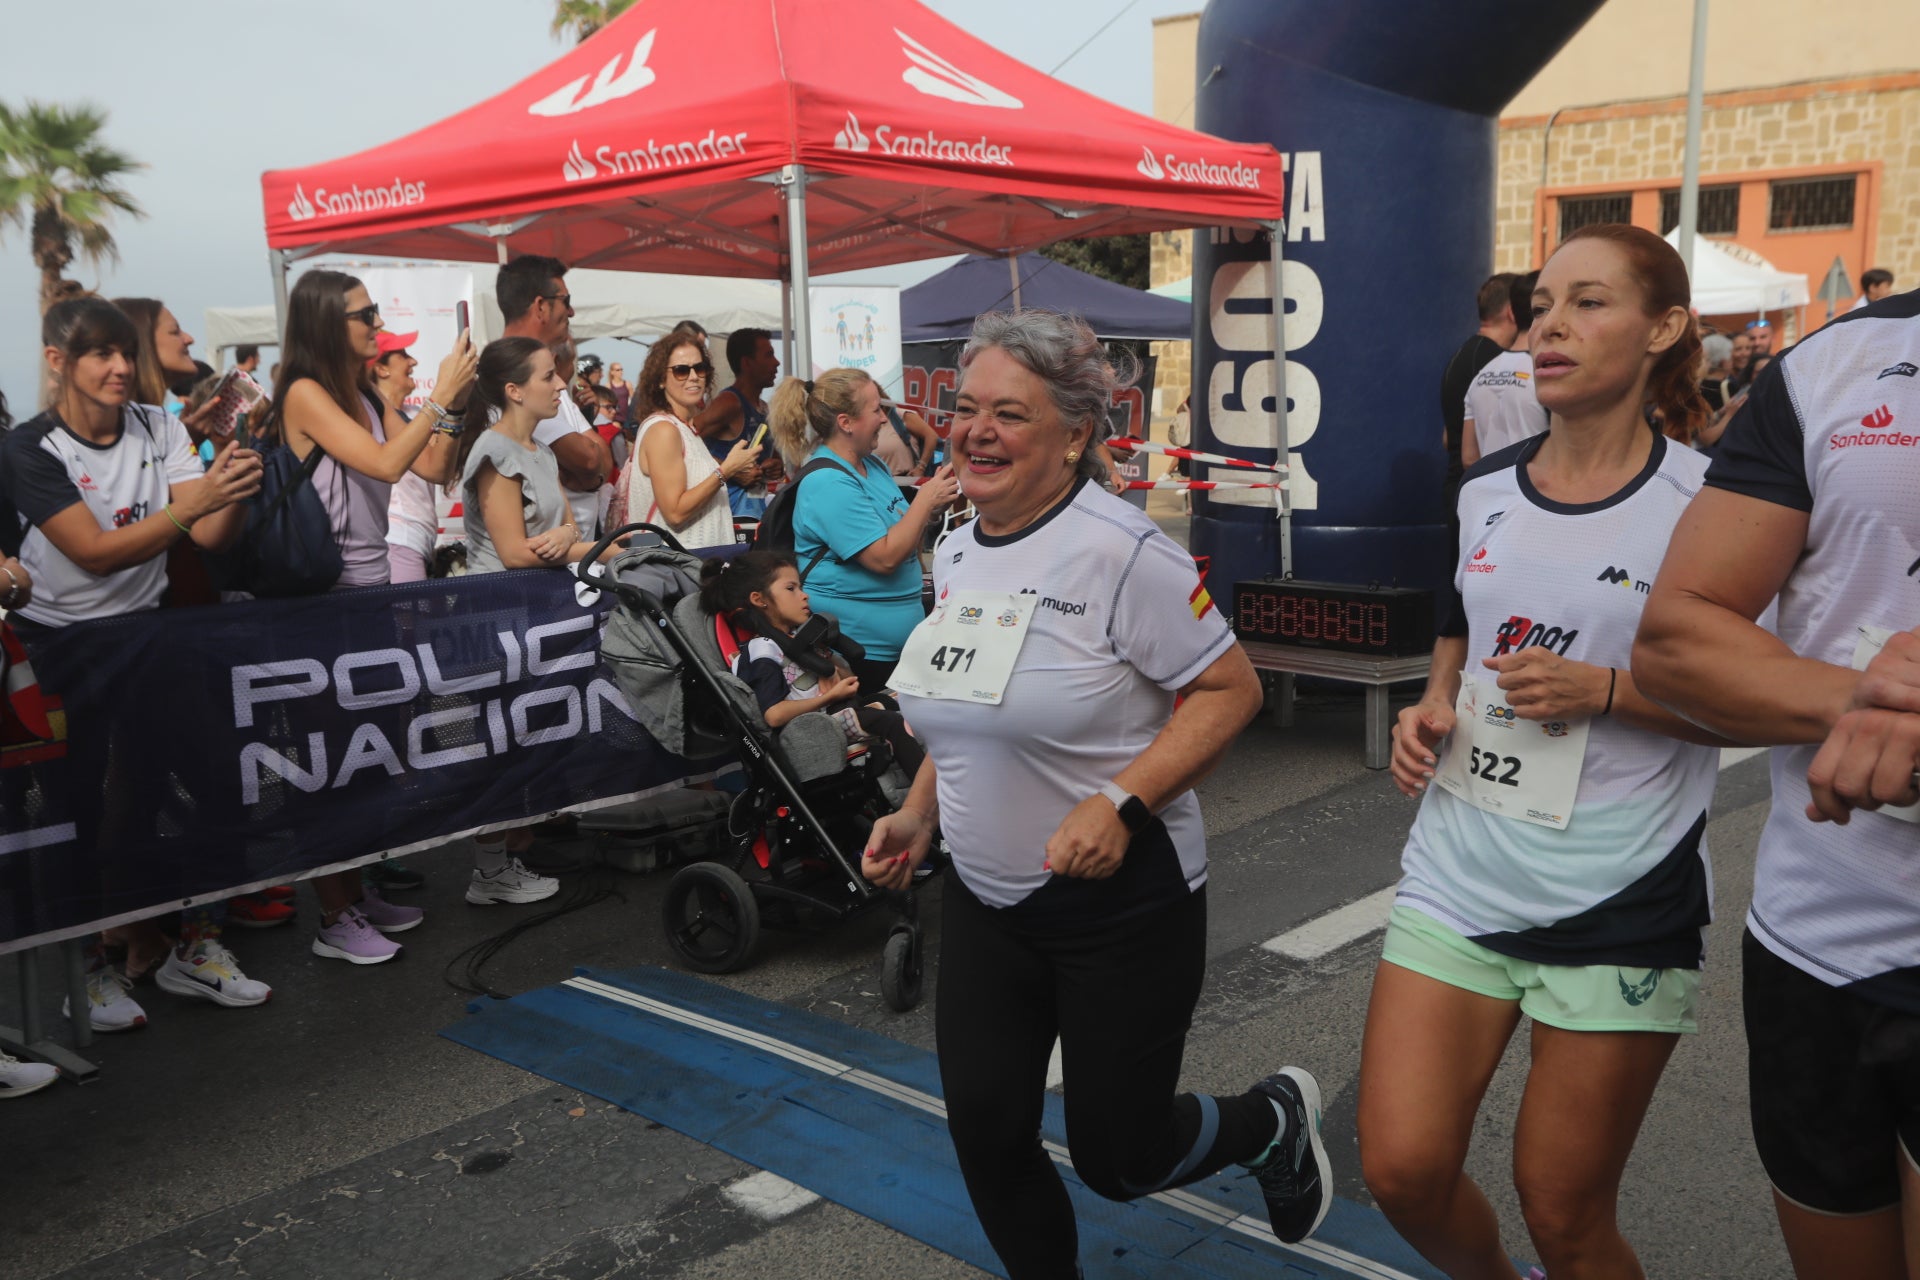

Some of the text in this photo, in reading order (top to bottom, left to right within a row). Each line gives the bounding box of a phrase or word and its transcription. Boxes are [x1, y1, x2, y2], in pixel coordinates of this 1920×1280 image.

[596, 129, 748, 176] Santander
[875, 125, 1015, 166] Santander
[1165, 154, 1260, 189] Santander
[315, 177, 426, 217] Santander
[838, 354, 877, 368] UNIPER
[1830, 431, 1920, 450] Santander
[1041, 597, 1087, 616] mupol
[231, 612, 606, 728] POLIC
[930, 646, 977, 673] 471
[742, 735, 761, 759] kimba
[1470, 746, 1521, 787] 522
